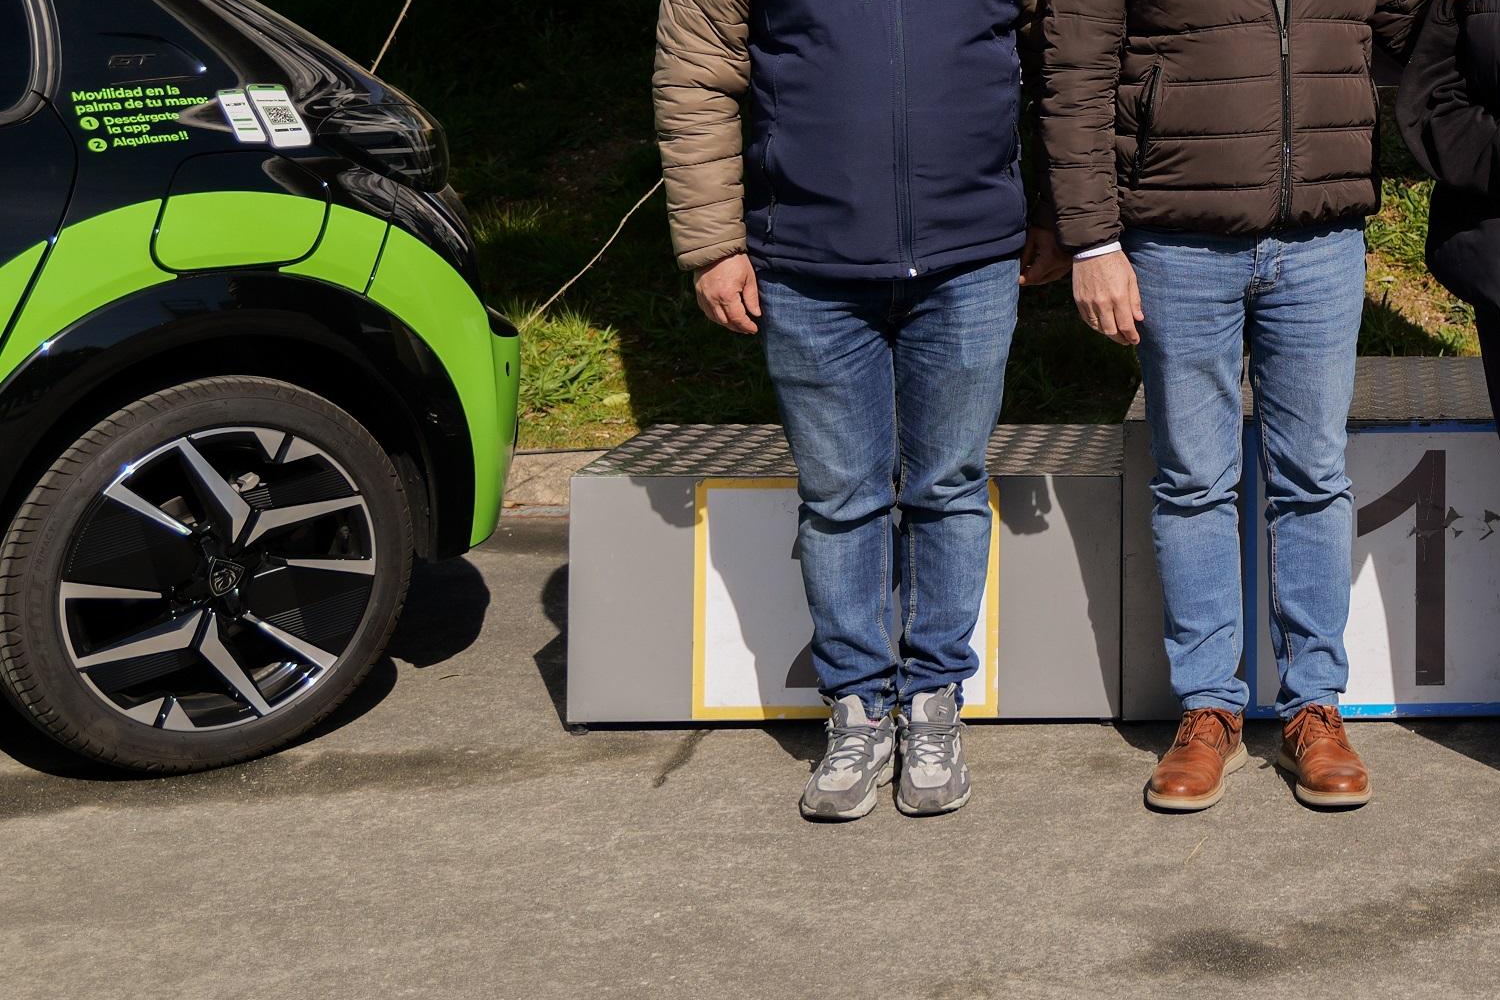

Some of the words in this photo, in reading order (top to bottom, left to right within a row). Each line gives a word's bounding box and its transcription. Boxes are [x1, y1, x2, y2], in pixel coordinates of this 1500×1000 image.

[71, 87, 143, 102] Movilidad
[146, 87, 165, 97] en
[166, 85, 180, 96] la
[75, 101, 122, 116] palma
[125, 99, 144, 109] de
[146, 98, 163, 108] tu
[165, 96, 209, 107] mano:
[103, 111, 181, 126] Descárgate
[107, 125, 121, 134] la
[123, 123, 151, 134] app
[1357, 449, 1446, 686] 1
